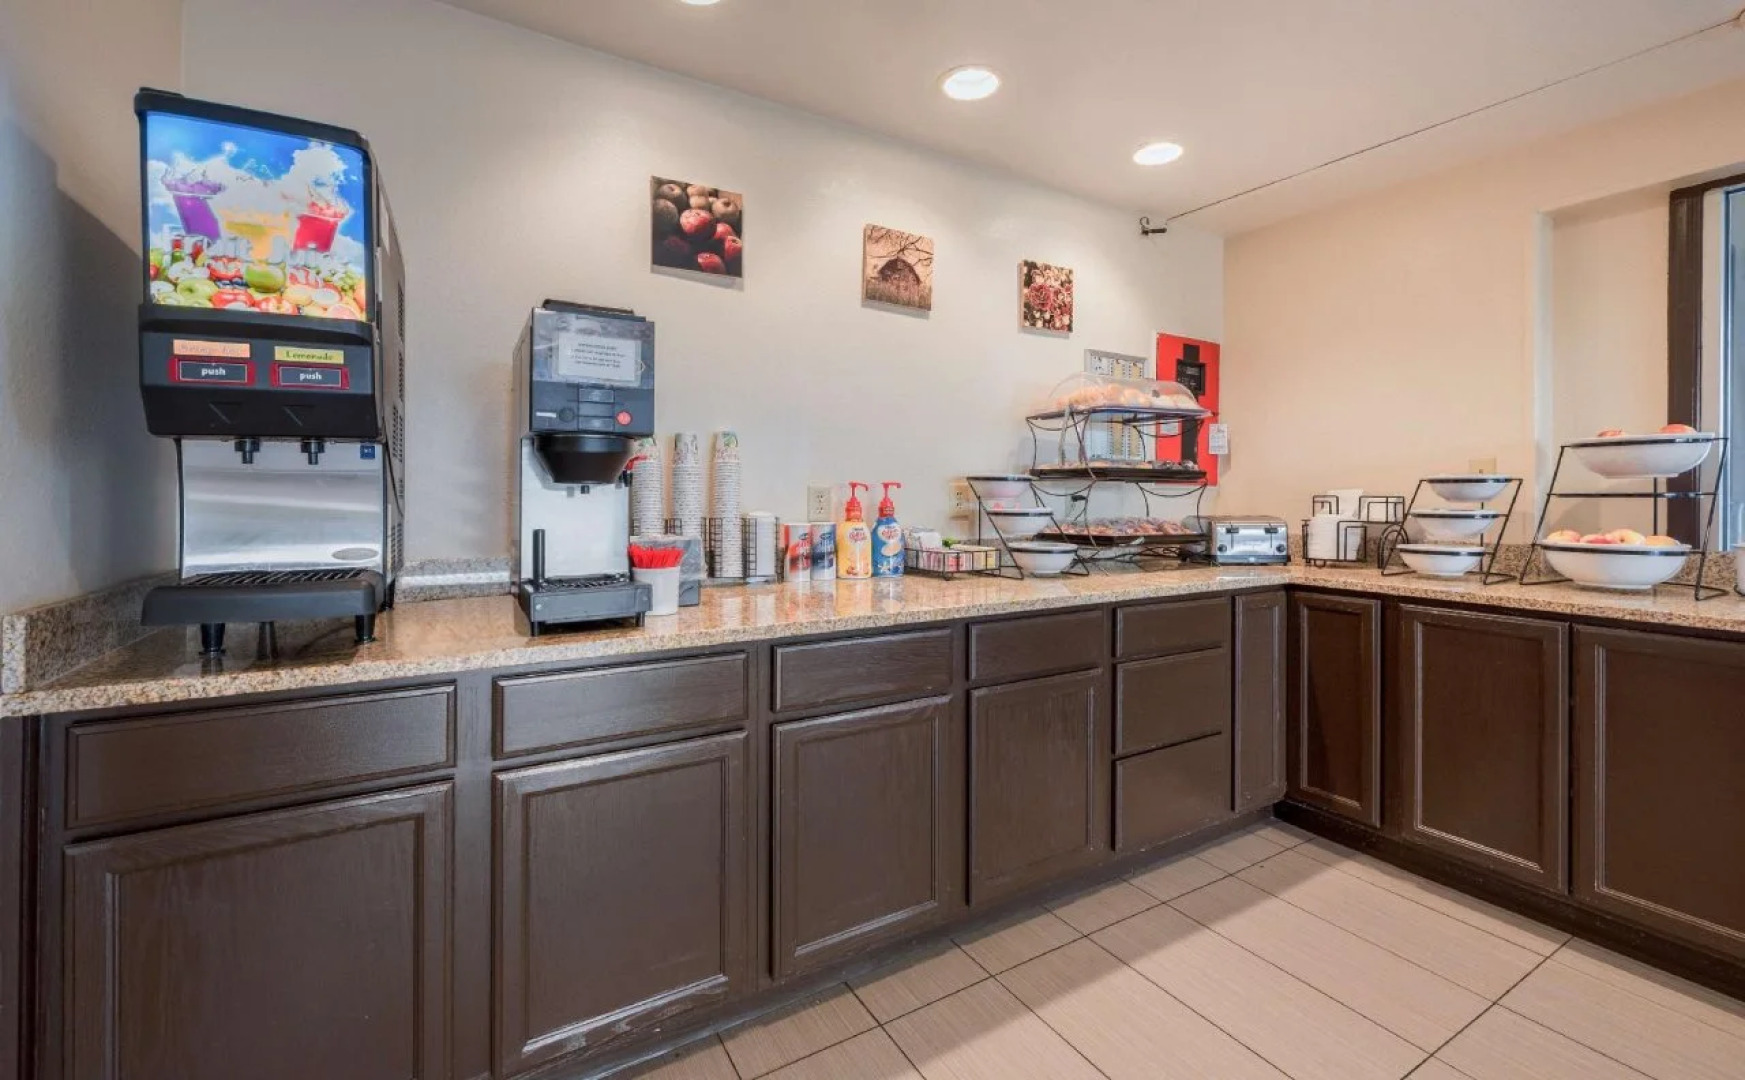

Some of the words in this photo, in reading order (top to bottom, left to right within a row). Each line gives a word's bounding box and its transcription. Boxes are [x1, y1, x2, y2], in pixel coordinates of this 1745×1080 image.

[285, 350, 333, 361] Lemonade
[201, 367, 226, 377] push
[299, 371, 323, 381] push
